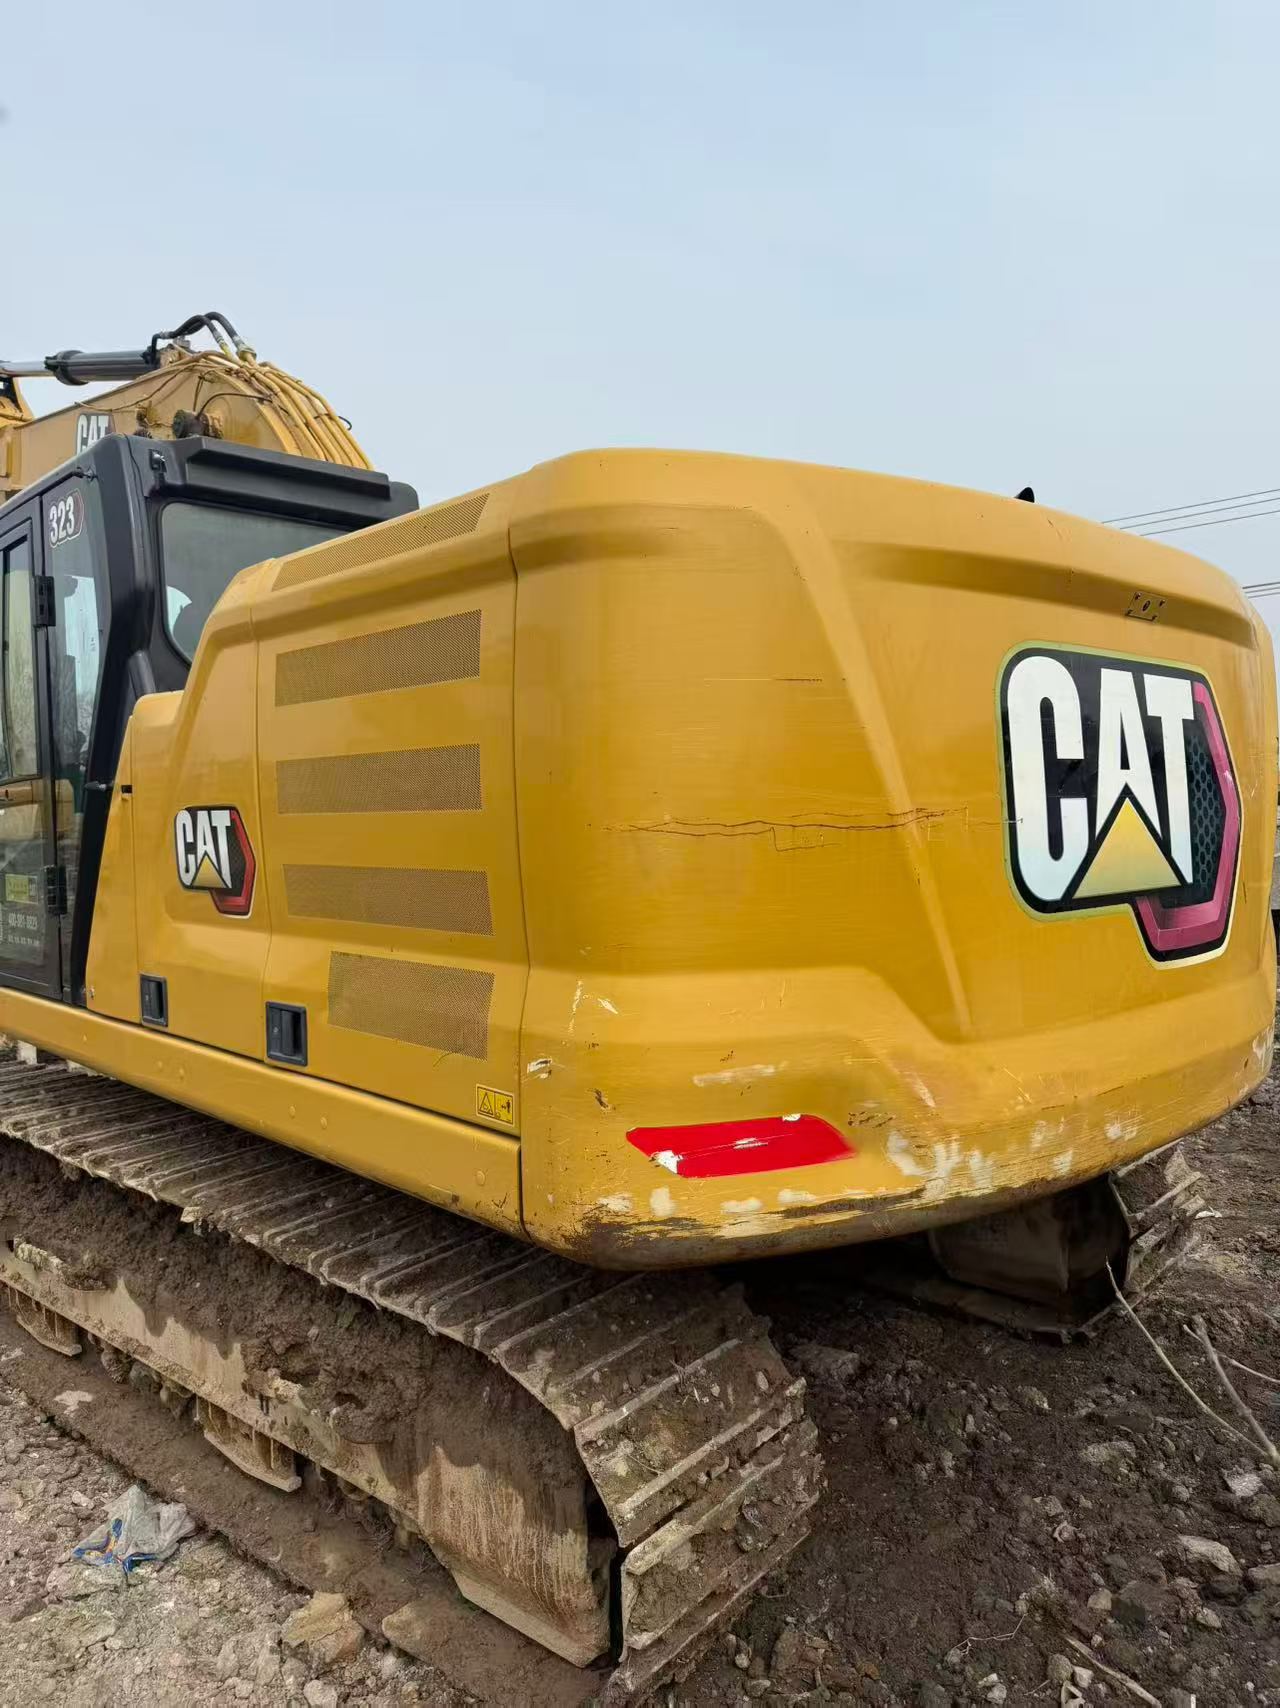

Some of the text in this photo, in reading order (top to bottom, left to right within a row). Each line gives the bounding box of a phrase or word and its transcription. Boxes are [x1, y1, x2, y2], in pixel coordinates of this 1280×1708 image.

[49, 495, 75, 544] 323
[1007, 655, 1194, 901] CAT
[175, 809, 232, 889] CAT
